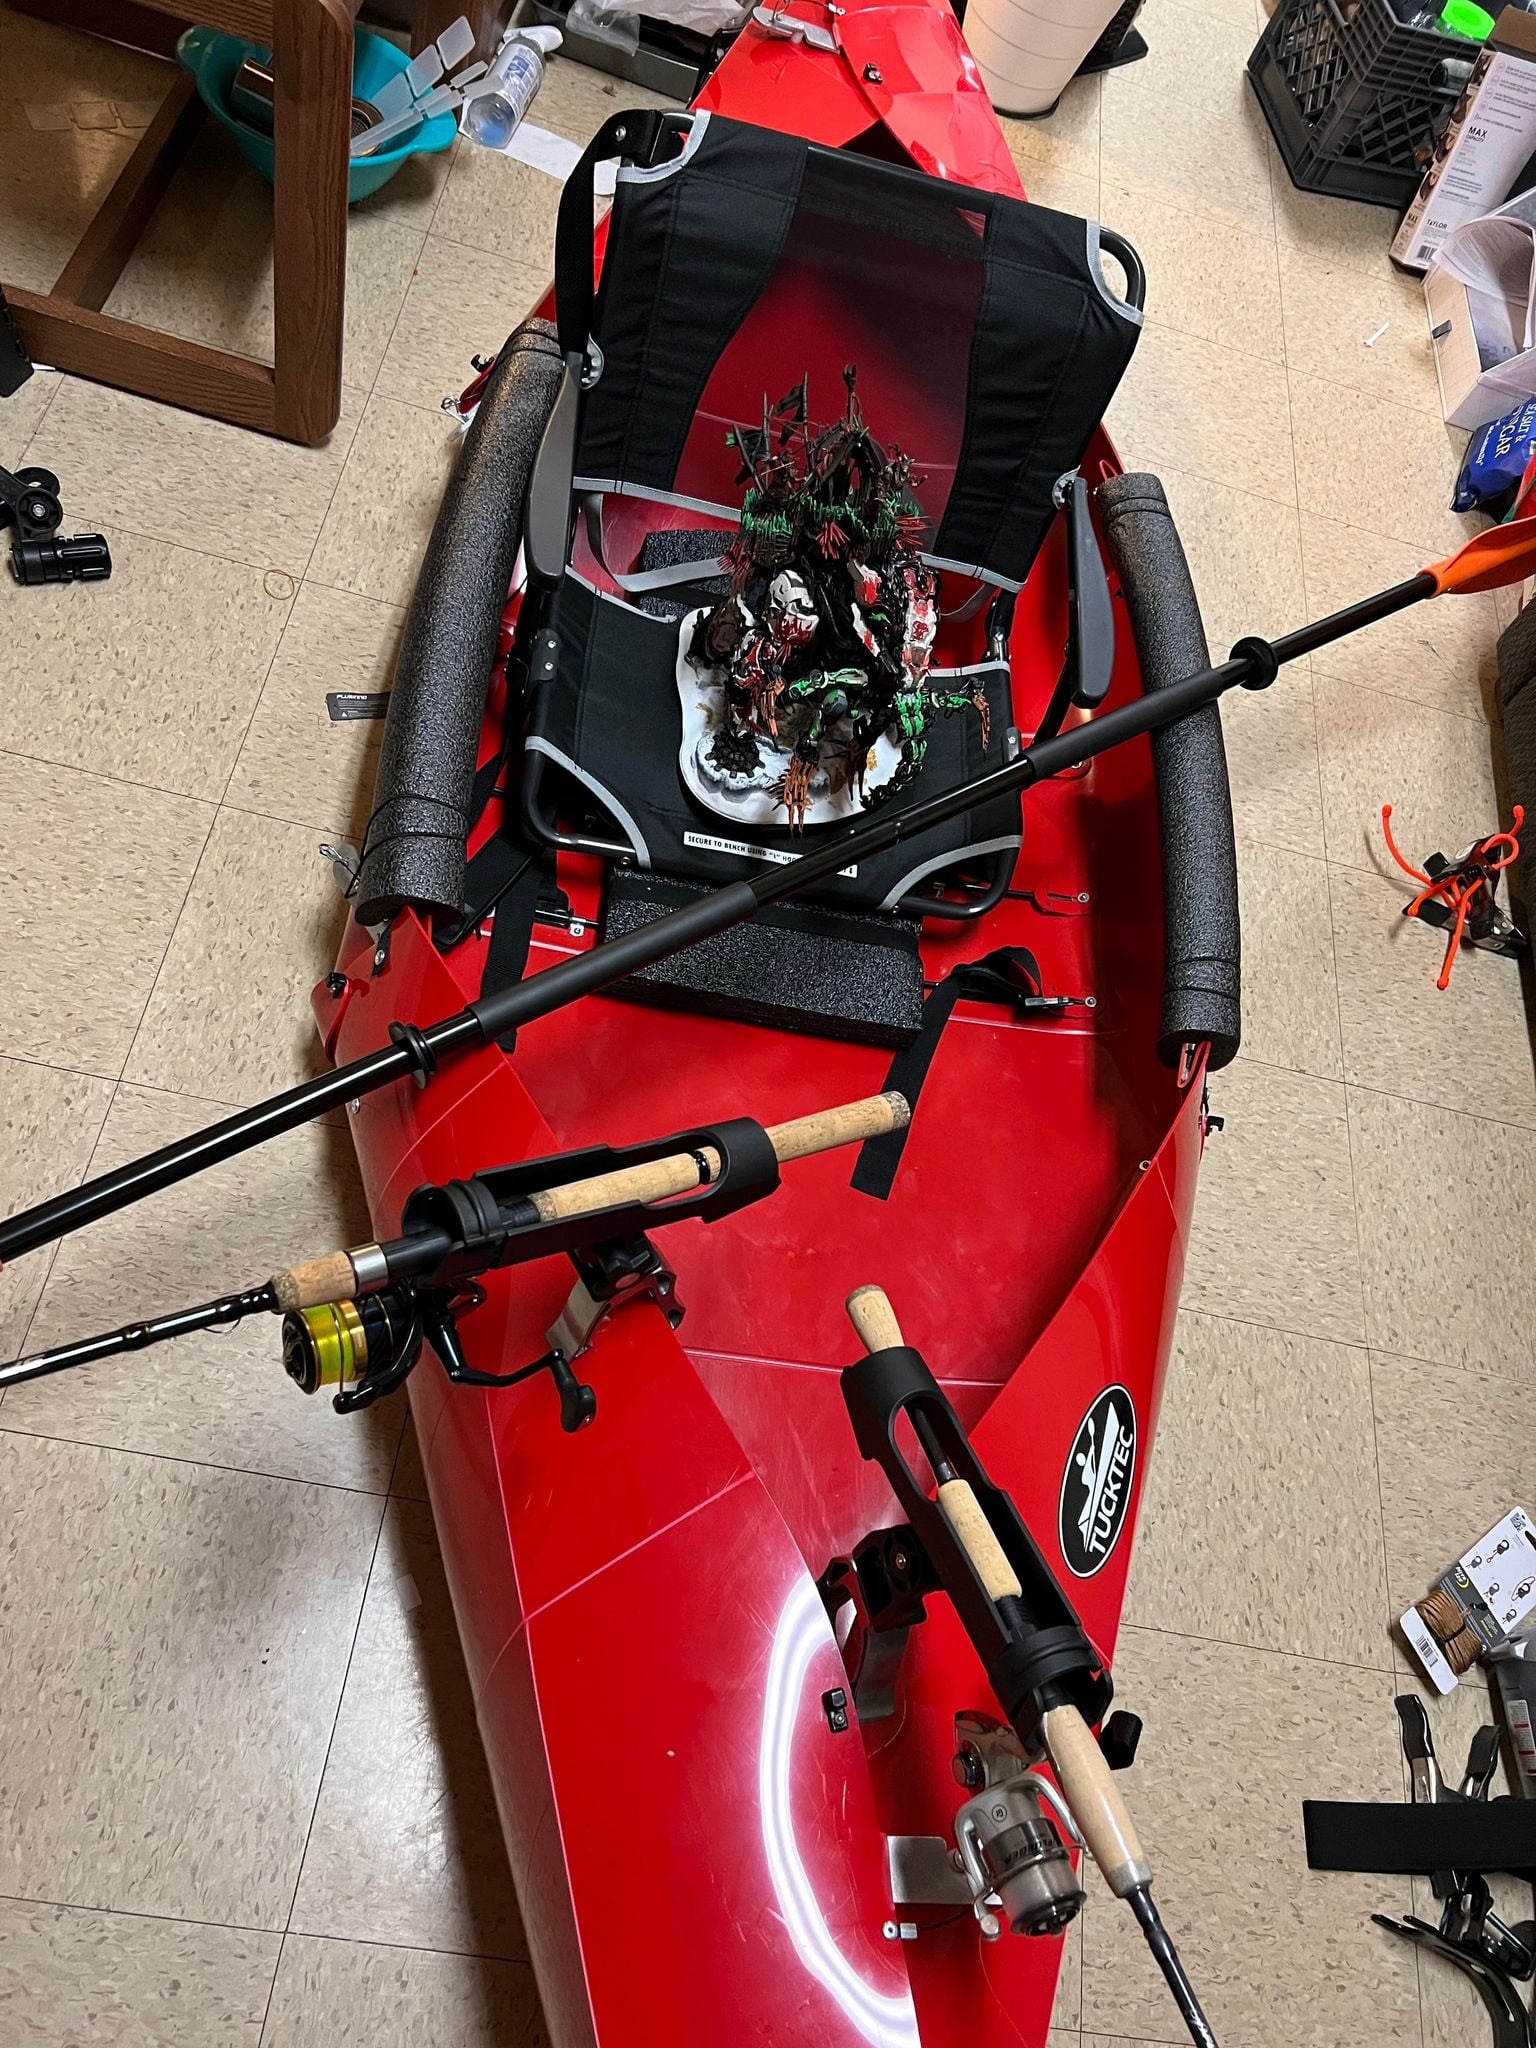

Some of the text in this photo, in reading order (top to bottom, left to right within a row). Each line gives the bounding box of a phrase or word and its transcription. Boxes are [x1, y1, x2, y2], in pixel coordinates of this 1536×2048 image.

[1468, 126, 1488, 138] MAX
[1426, 218, 1448, 229] TAYLOR
[688, 835, 712, 846] SECURE
[714, 840, 722, 848] TO
[724, 843, 746, 852] BENCH
[747, 847, 767, 857] USING
[1089, 1425, 1133, 1554] TUCKTEC
